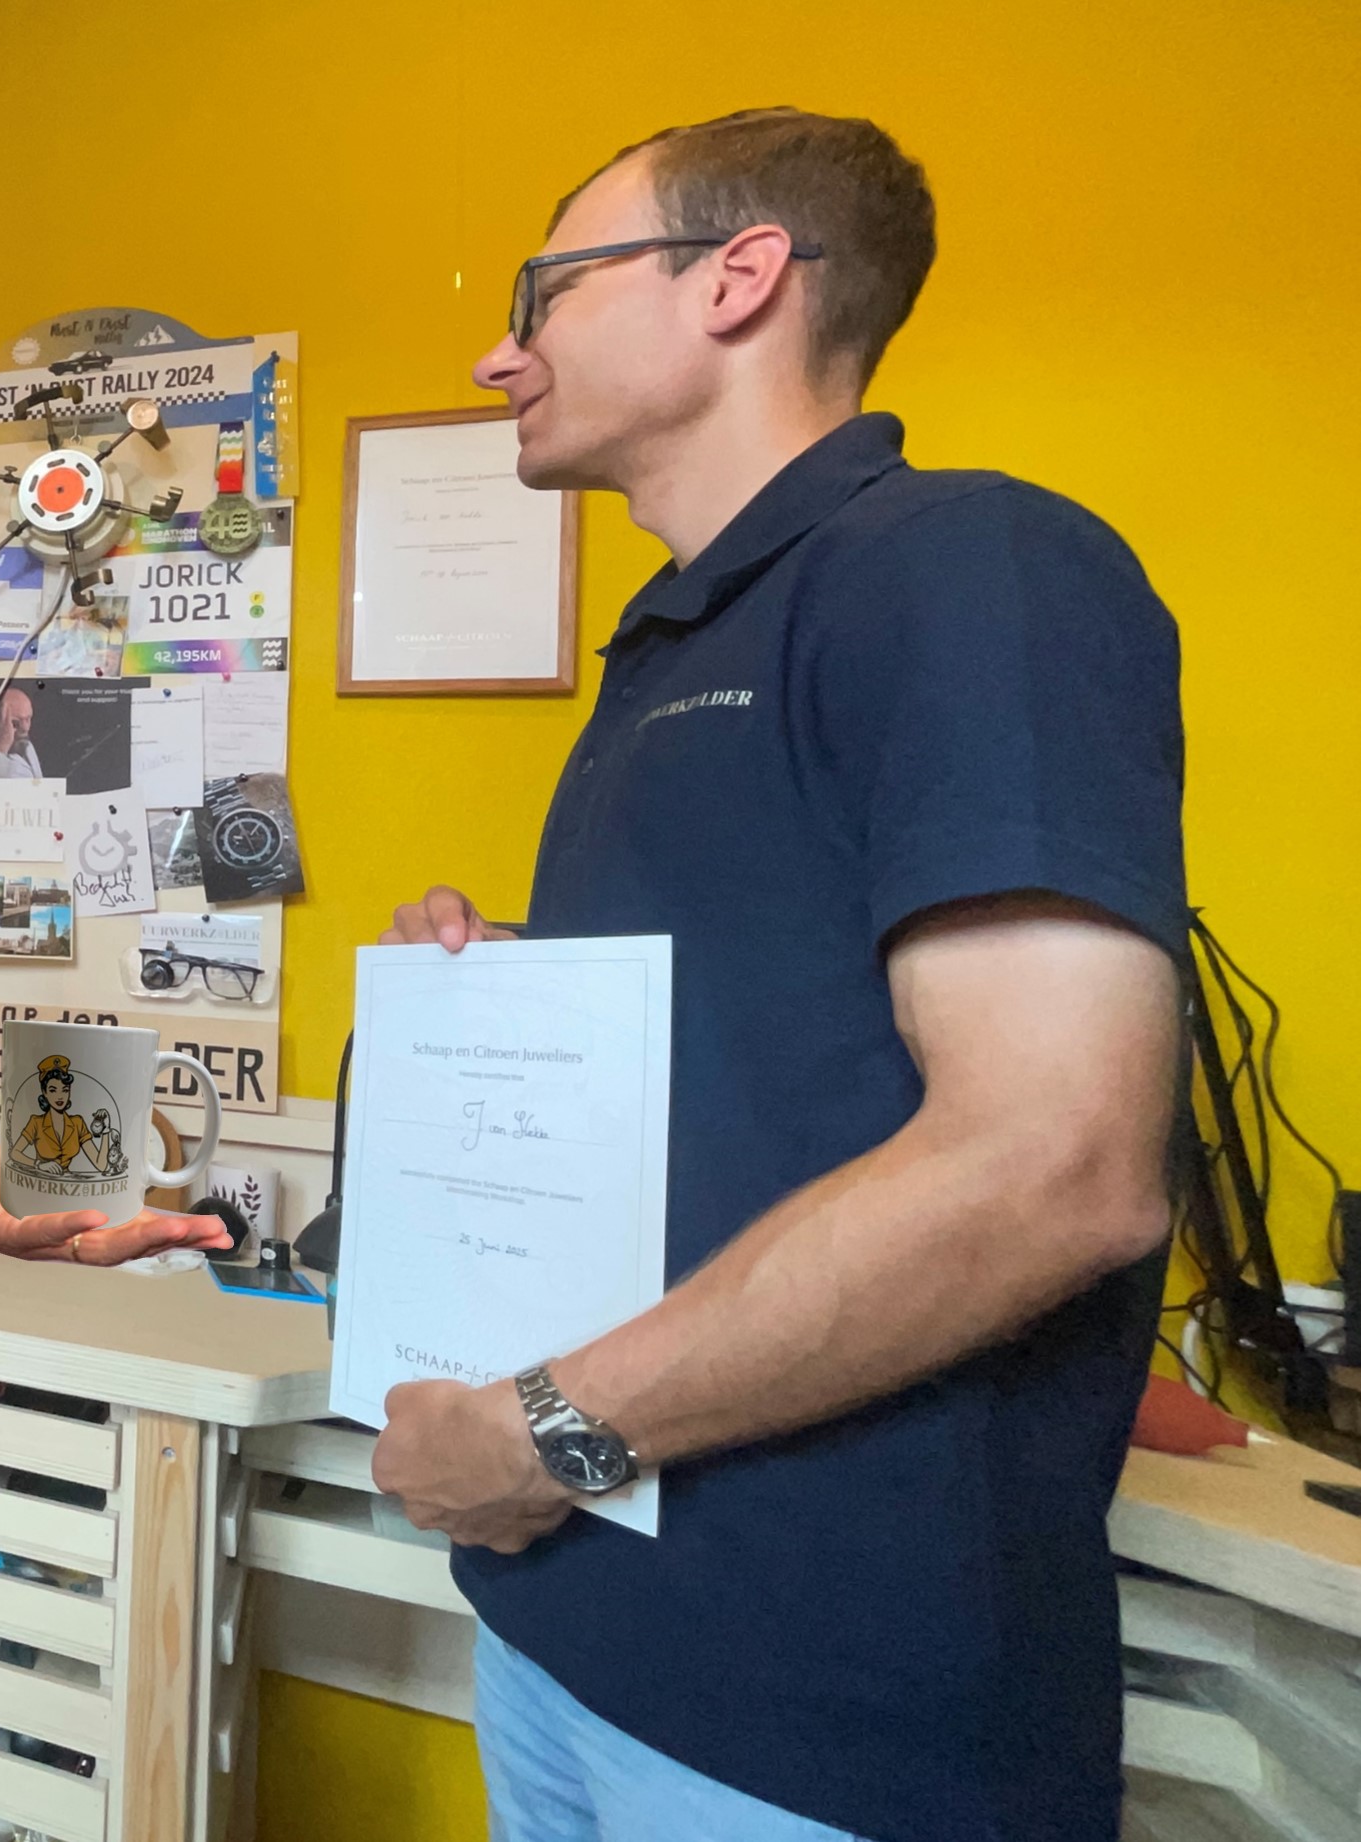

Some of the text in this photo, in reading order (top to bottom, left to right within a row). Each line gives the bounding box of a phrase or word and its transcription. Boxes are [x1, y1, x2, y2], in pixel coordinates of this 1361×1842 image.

[102, 370, 159, 395] RALLY
[165, 364, 214, 389] 2024
[139, 562, 243, 589] JORICK
[149, 592, 230, 623] 1021
[154, 650, 221, 664] 42,195KM
[412, 1042, 583, 1064] Schaap en Citroen Juweliers
[395, 1344, 463, 1376] SCHAAP
